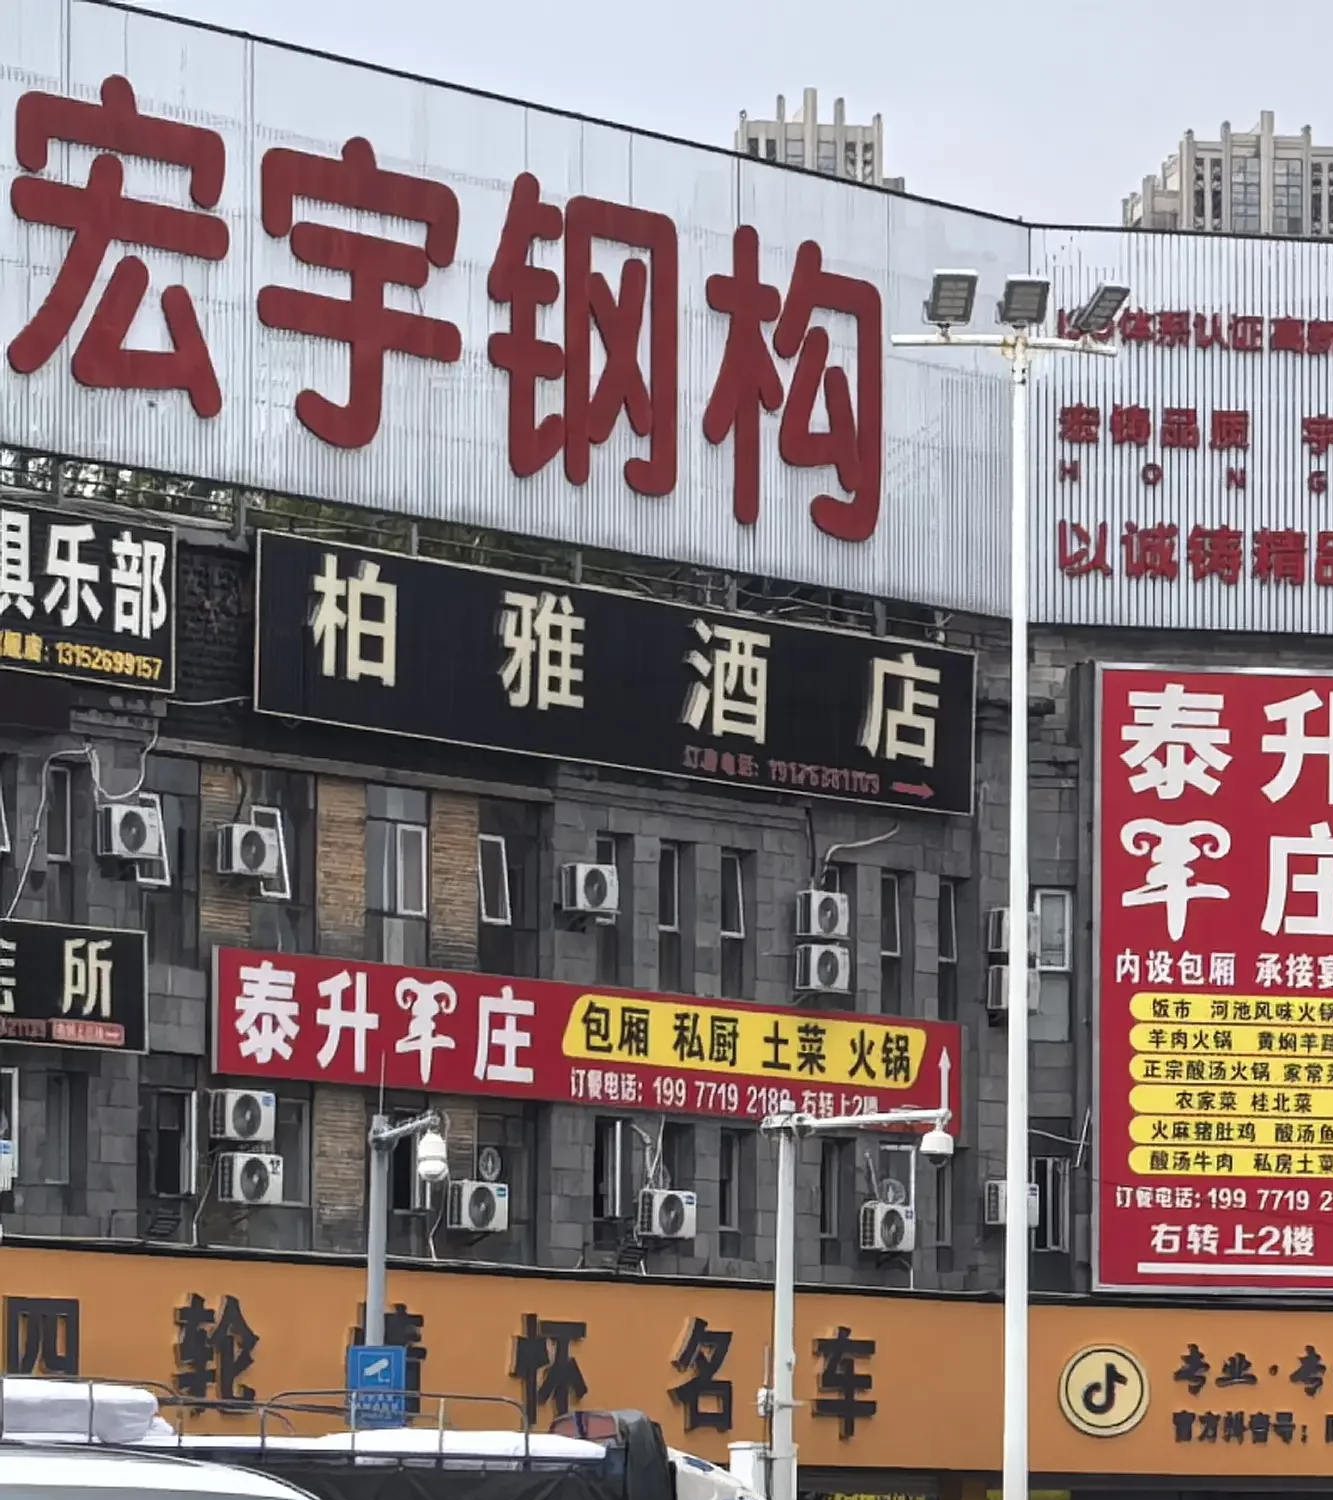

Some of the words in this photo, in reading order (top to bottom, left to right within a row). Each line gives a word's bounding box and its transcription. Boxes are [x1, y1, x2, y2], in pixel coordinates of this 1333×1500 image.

[7, 75, 883, 542] 宏宇钢构
[310, 553, 941, 767] 柏雅酒店
[1116, 949, 1236, 987] 内设包厢
[581, 1000, 650, 1057] 包厢
[673, 1011, 740, 1067] 私厨
[761, 1021, 827, 1075] 土菜
[847, 1029, 911, 1083] 火锅
[1148, 1029, 1233, 1050] 羊肉火锅
[653, 1076, 687, 1107] 199
[694, 1081, 740, 1112] 7719
[1176, 1091, 1238, 1111] 农家菜
[1250, 1092, 1312, 1113] 桂北菜
[1150, 1151, 1233, 1172] 酸汤牛肉
[1208, 1188, 1246, 1209] 199
[1257, 1189, 1310, 1210] 7719
[1151, 1223, 1315, 1257] 右转上2楼
